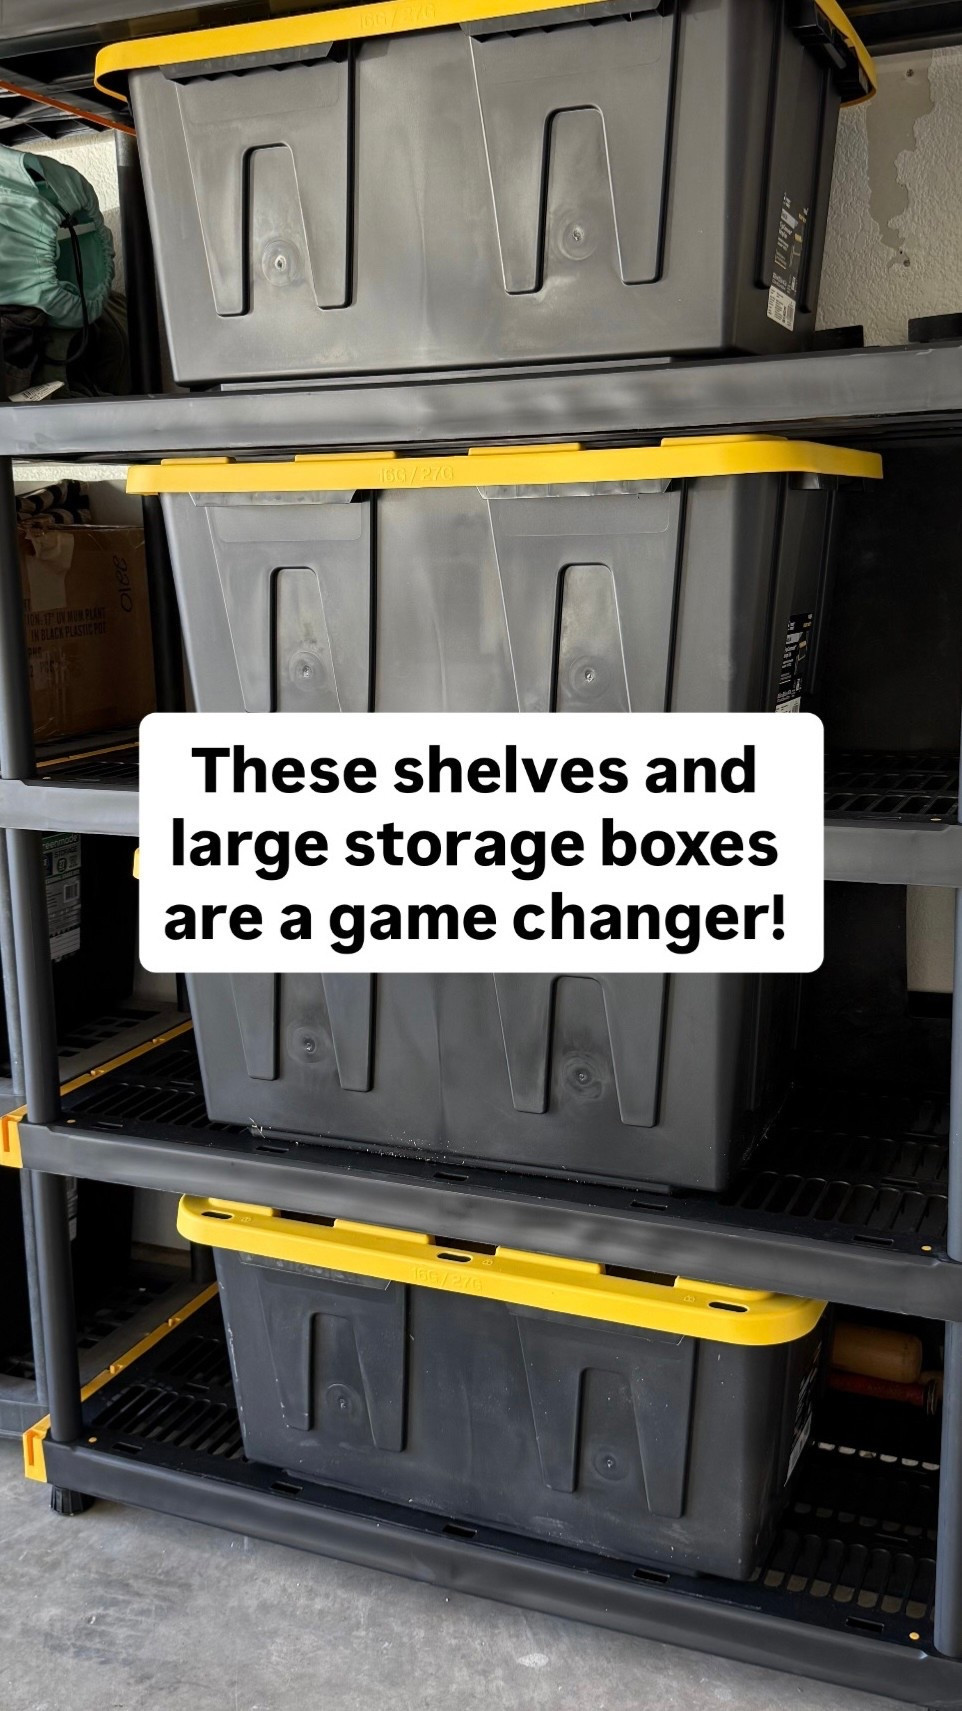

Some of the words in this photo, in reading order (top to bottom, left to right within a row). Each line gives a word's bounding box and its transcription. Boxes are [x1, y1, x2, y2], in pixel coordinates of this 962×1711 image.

[85, 606, 106, 621] PLANT
[41, 626, 64, 641] BLACK
[65, 623, 93, 638] PLASTIC
[94, 621, 107, 635] POT
[42, 834, 78, 850] reenmade
